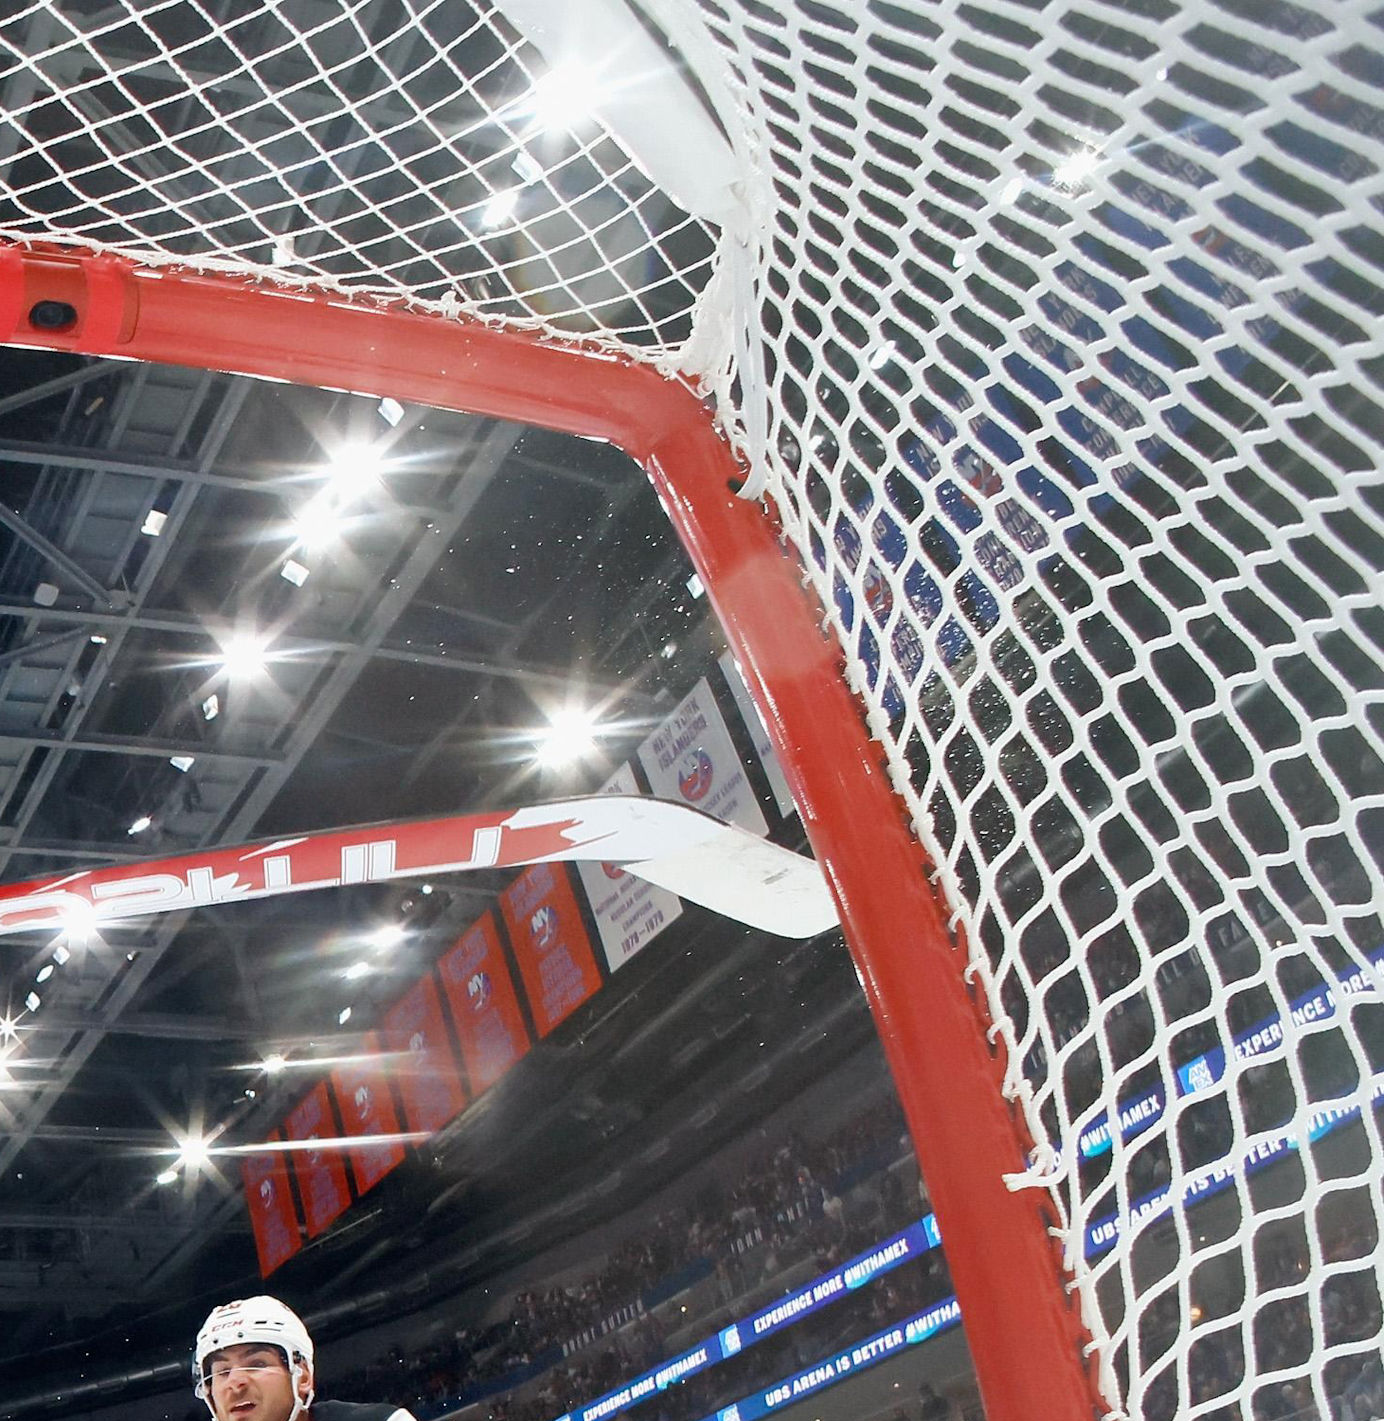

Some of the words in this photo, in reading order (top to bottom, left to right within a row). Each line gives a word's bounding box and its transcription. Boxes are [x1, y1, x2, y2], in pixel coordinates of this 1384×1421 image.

[1234, 996, 1327, 1061] EXPERNCE
[1081, 1094, 1161, 1151] #WITAMEX
[754, 1290, 813, 1334] EXPERIENCE
[813, 1274, 844, 1301] MORE
[844, 1238, 909, 1286] #WITHAMEX
[631, 1376, 656, 1400] MORE
[656, 1348, 708, 1387] #WITHAMEX
[765, 1385, 791, 1407] UBS
[793, 1363, 835, 1395] ARENA
[836, 1355, 851, 1373] IS
[852, 1329, 904, 1365] BETTER
[905, 1300, 961, 1340] #WITHA
